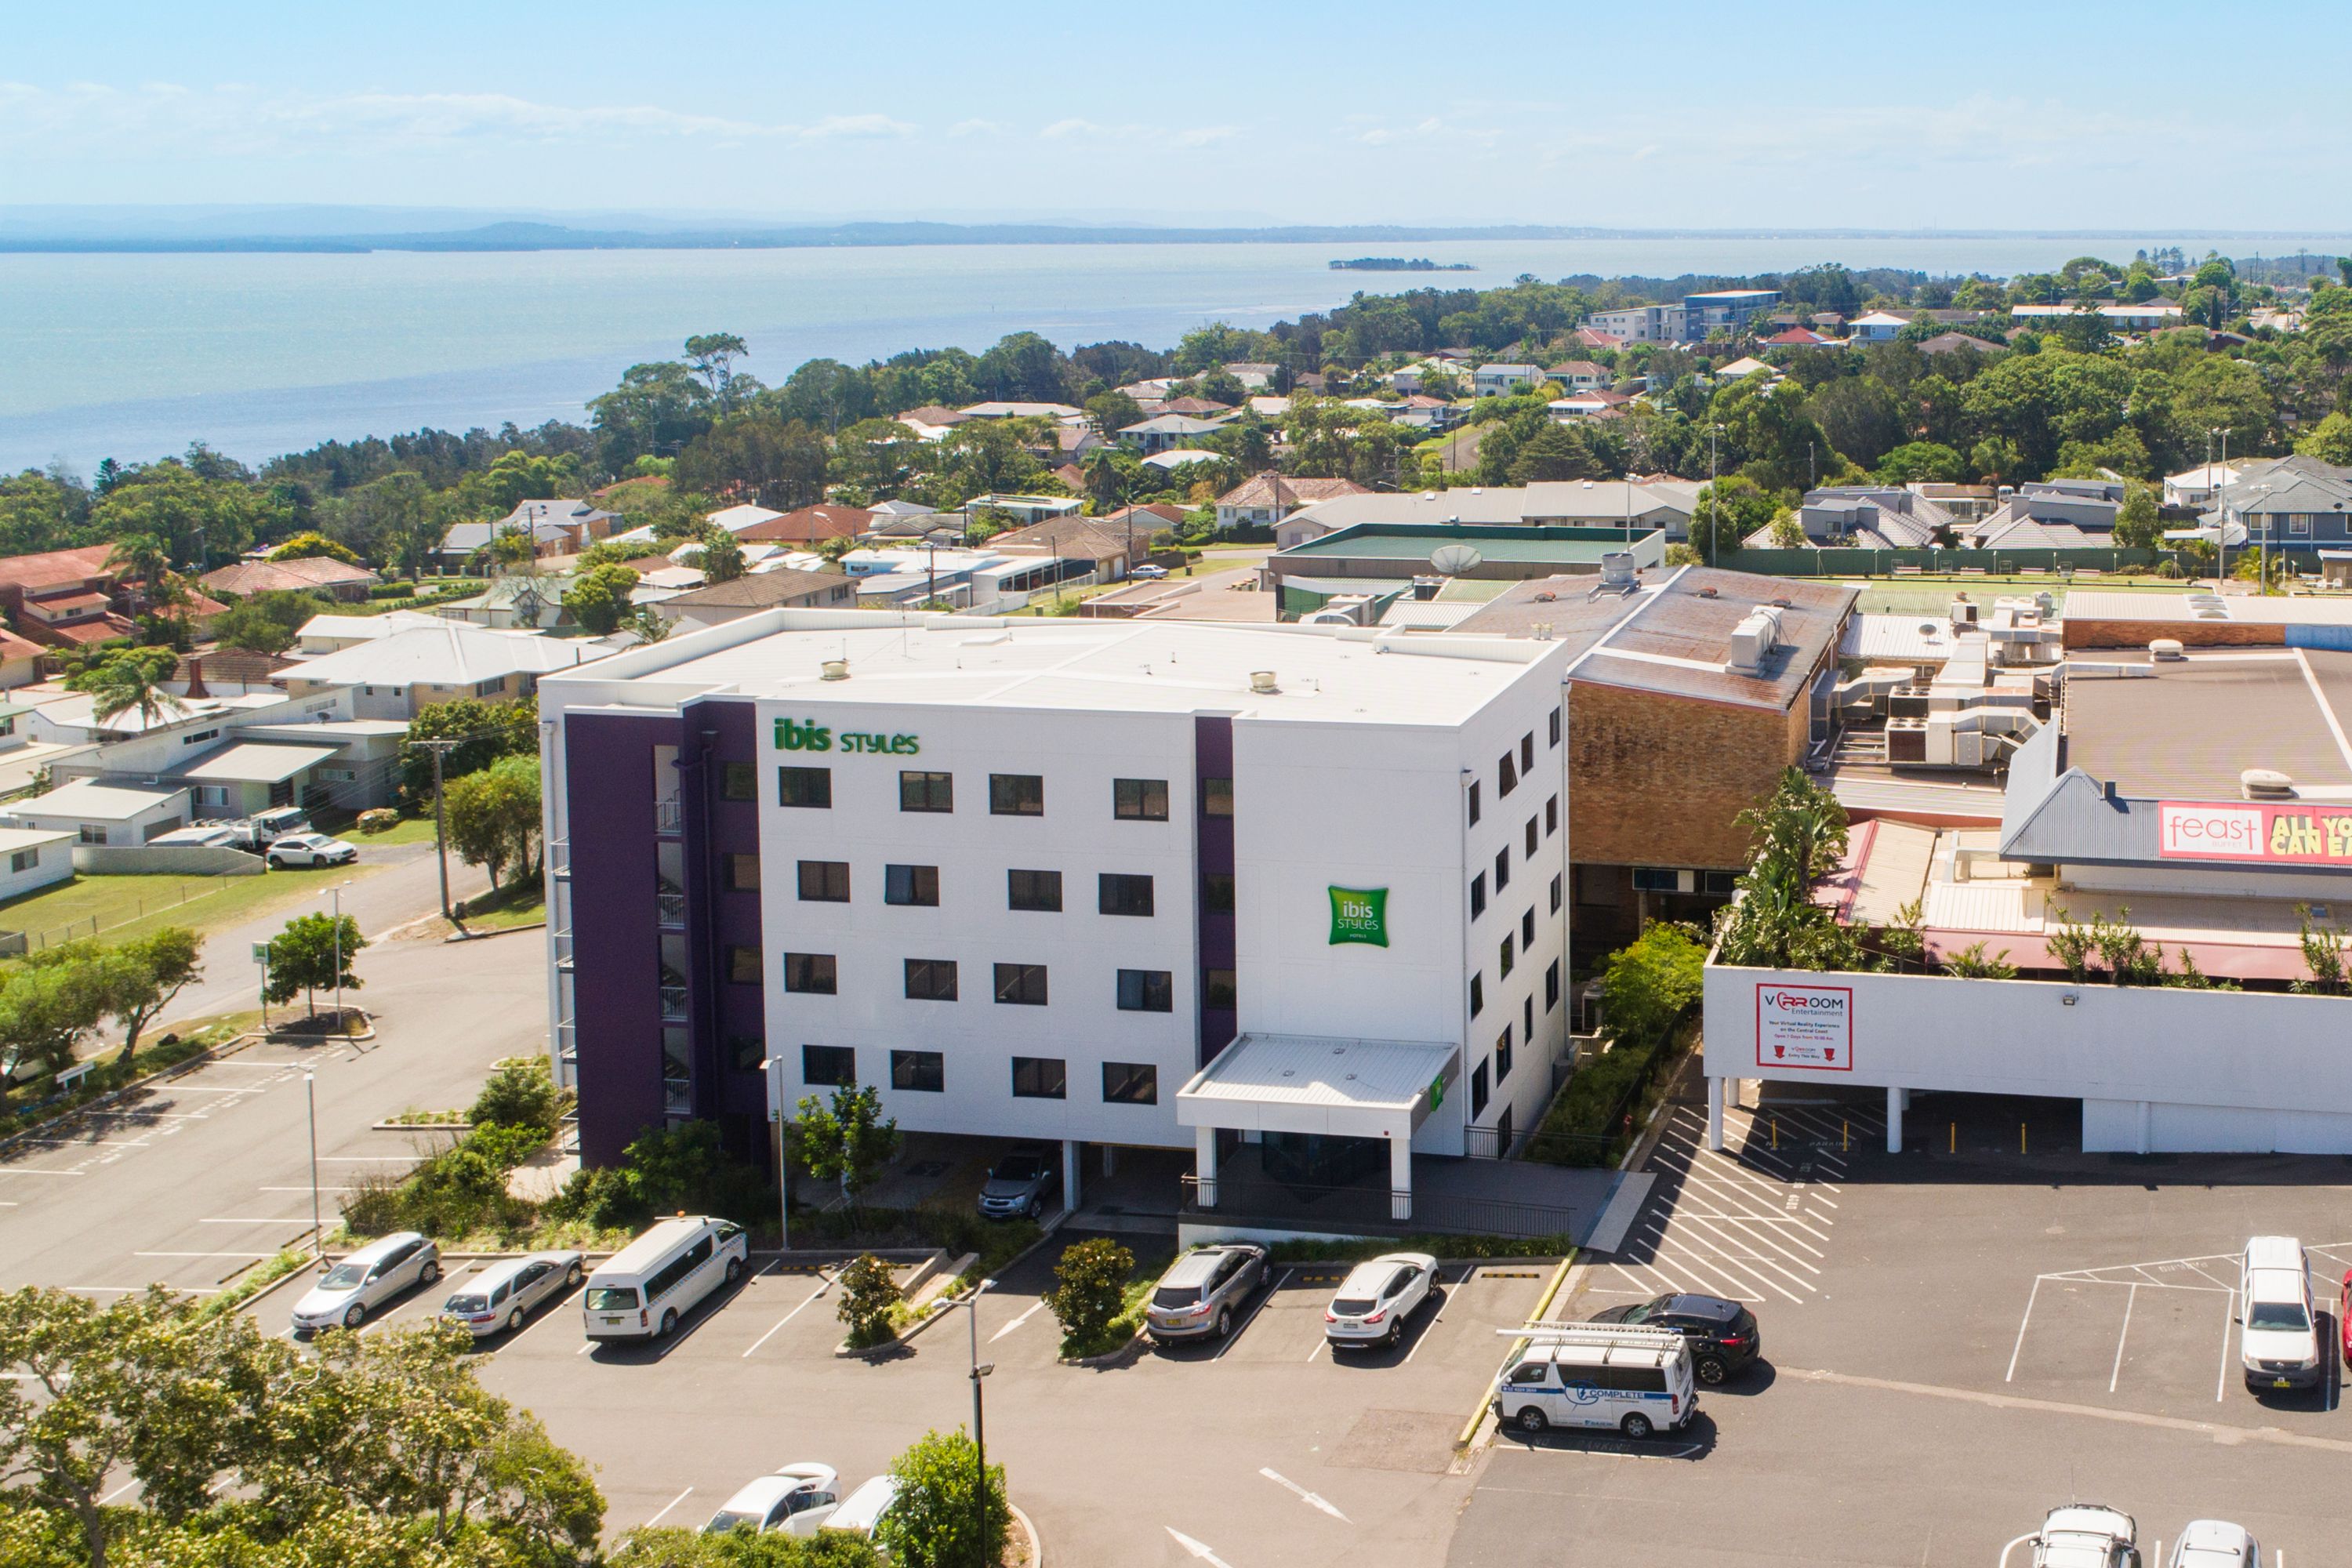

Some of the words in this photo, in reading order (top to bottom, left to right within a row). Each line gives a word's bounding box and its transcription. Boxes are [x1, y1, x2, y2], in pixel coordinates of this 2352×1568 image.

[775, 717, 833, 752] ibis
[2169, 815, 2257, 851] feast
[2272, 815, 2321, 837] ALL
[2270, 836, 2322, 855] CAN
[1343, 900, 1374, 918] ibis
[1791, 1007, 1843, 1017] Entertainment
[1589, 1389, 1644, 1399] COMPLETE
